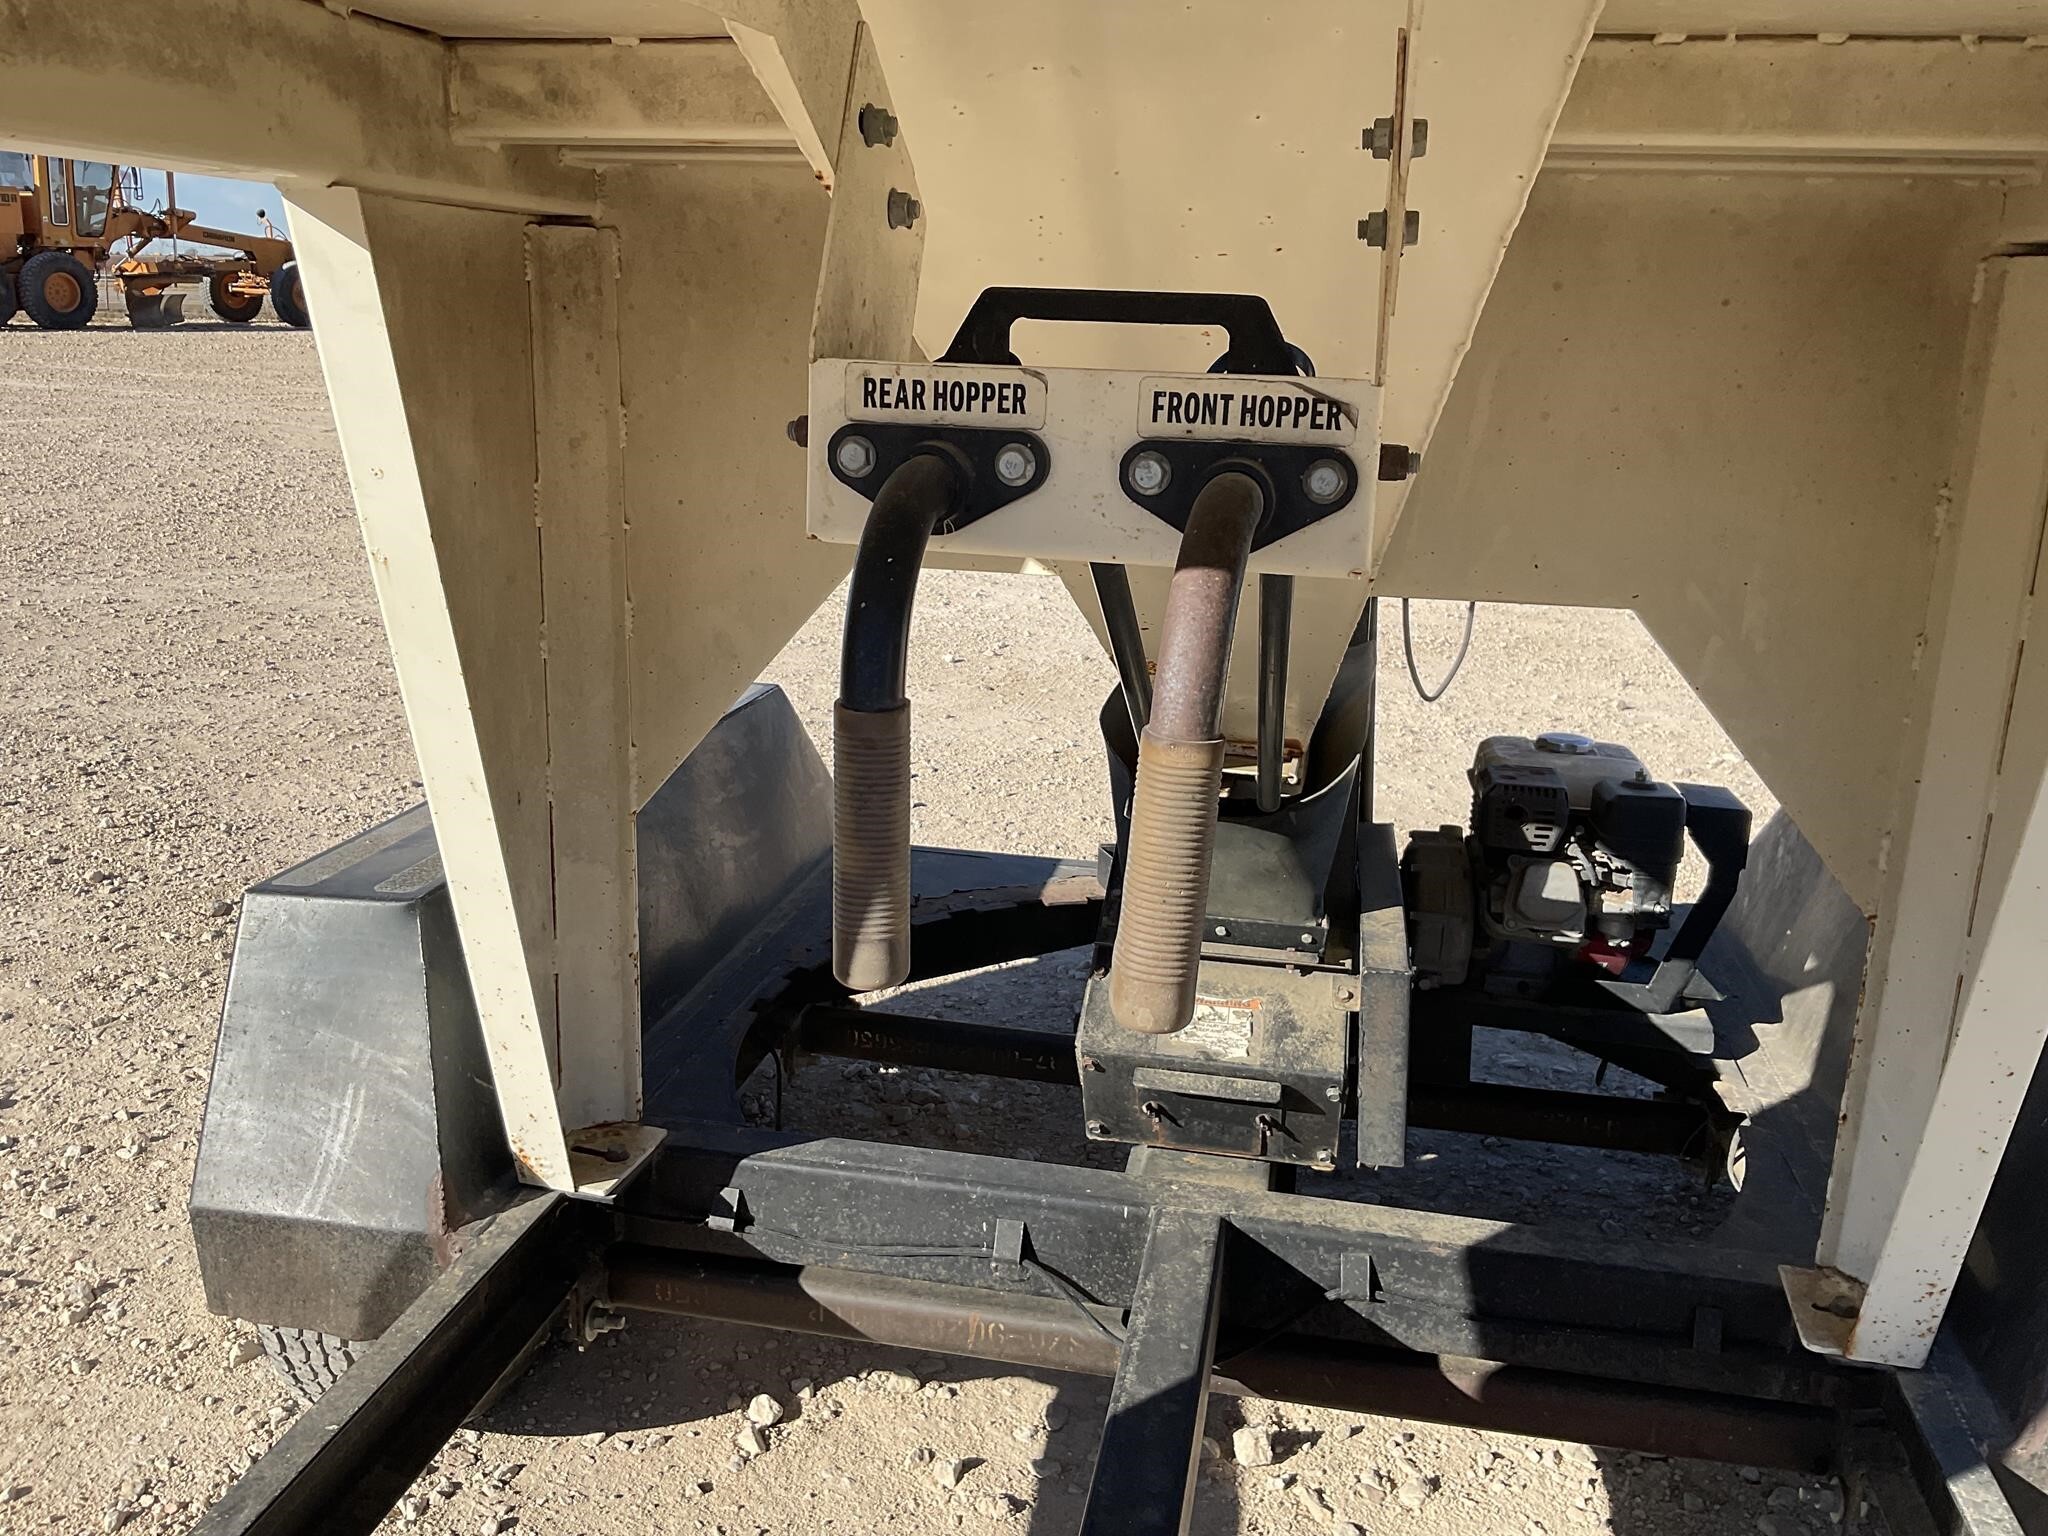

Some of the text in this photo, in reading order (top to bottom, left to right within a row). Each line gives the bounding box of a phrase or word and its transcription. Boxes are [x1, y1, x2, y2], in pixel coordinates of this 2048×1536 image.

[863, 377, 1027, 415] REAR HOPPER
[1152, 390, 1342, 431] FRONT HOPPER
